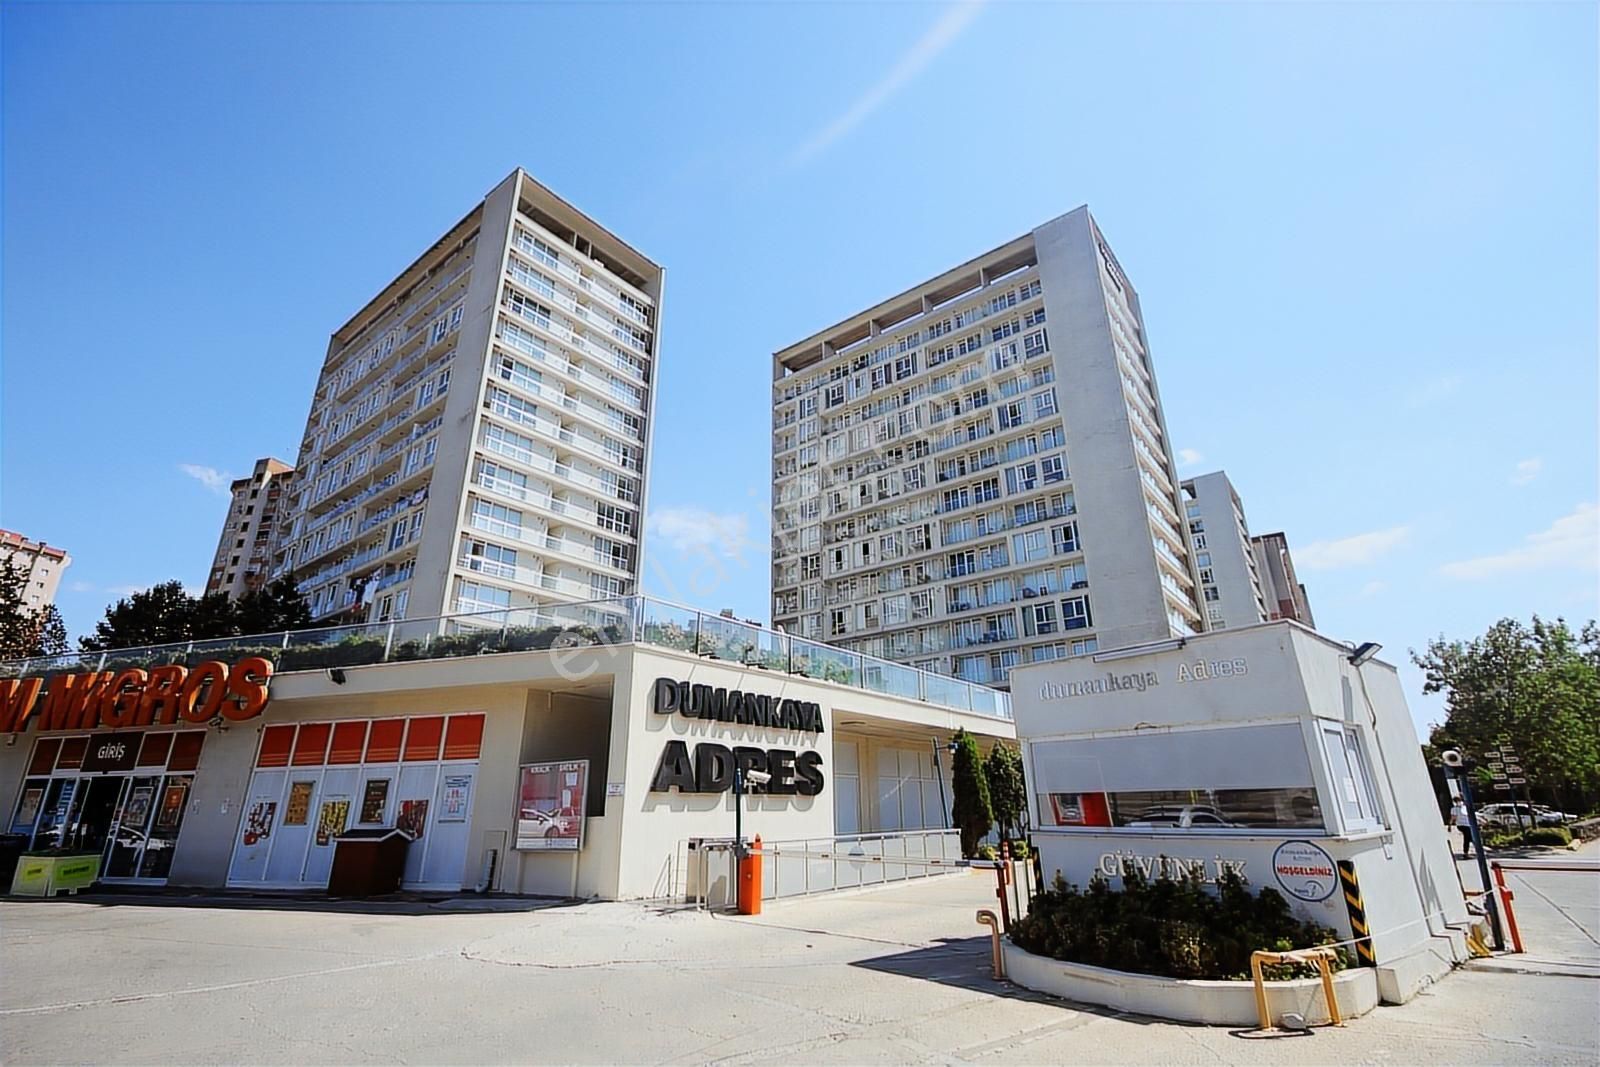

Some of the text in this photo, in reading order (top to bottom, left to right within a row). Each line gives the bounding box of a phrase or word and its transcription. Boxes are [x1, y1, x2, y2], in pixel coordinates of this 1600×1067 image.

[38, 657, 274, 730] MIGROS
[654, 677, 824, 733] DUMANKAYA
[1038, 657, 1249, 701] dumankaya Adres
[97, 742, 126, 761] GİRİŞ
[650, 740, 824, 796] ADRES
